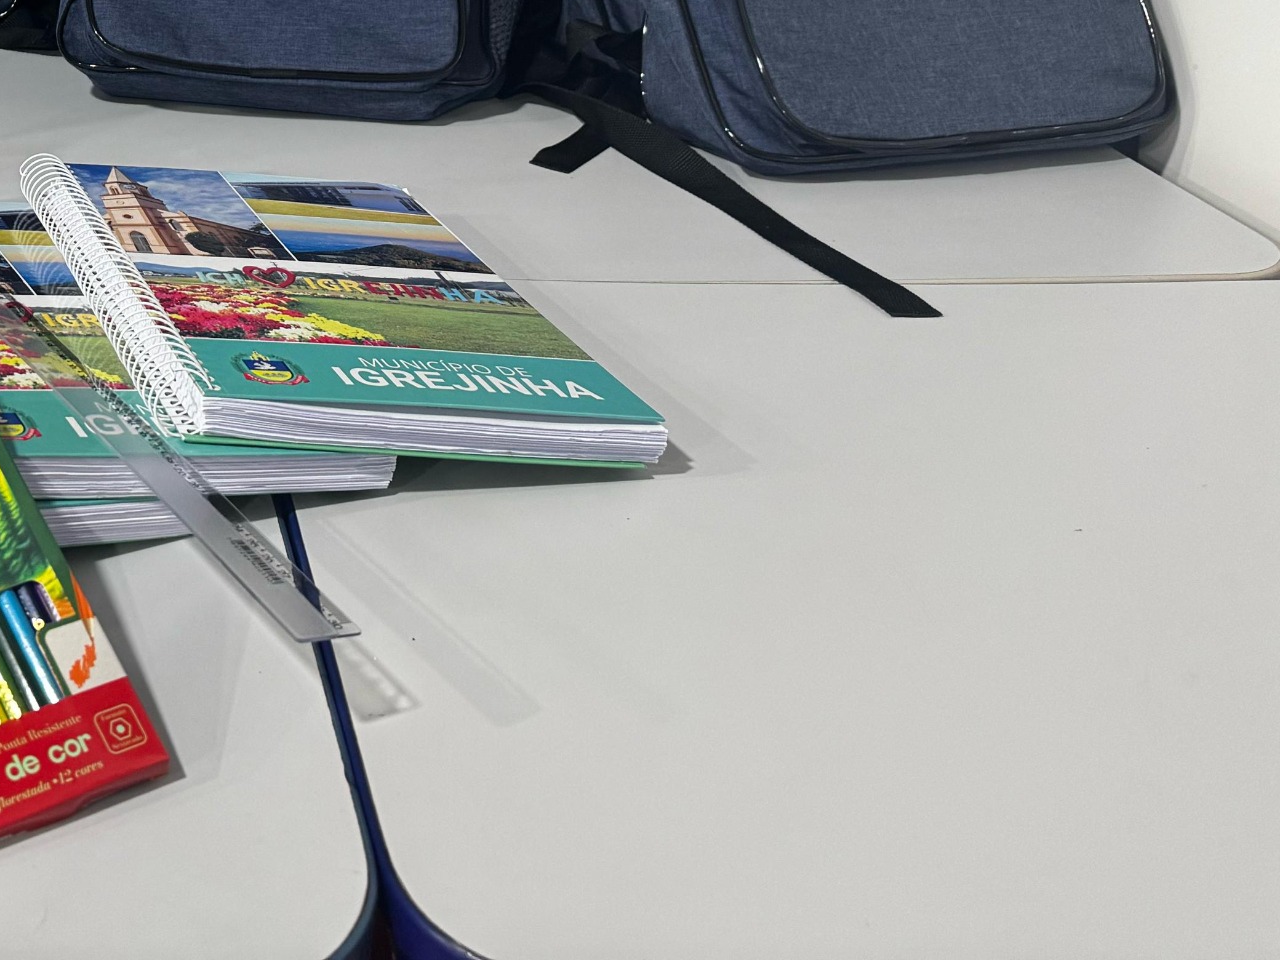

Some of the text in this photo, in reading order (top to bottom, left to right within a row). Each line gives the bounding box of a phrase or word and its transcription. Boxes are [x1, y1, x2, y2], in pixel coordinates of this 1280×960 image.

[196, 271, 506, 304] ICH IGREJINHA
[358, 357, 533, 378] MUNICÍPIO DE
[332, 365, 605, 401] IGREJINHA
[27, 715, 82, 740] Resistente
[5, 754, 41, 781] de
[48, 733, 92, 763] cor
[74, 761, 104, 778] cores
